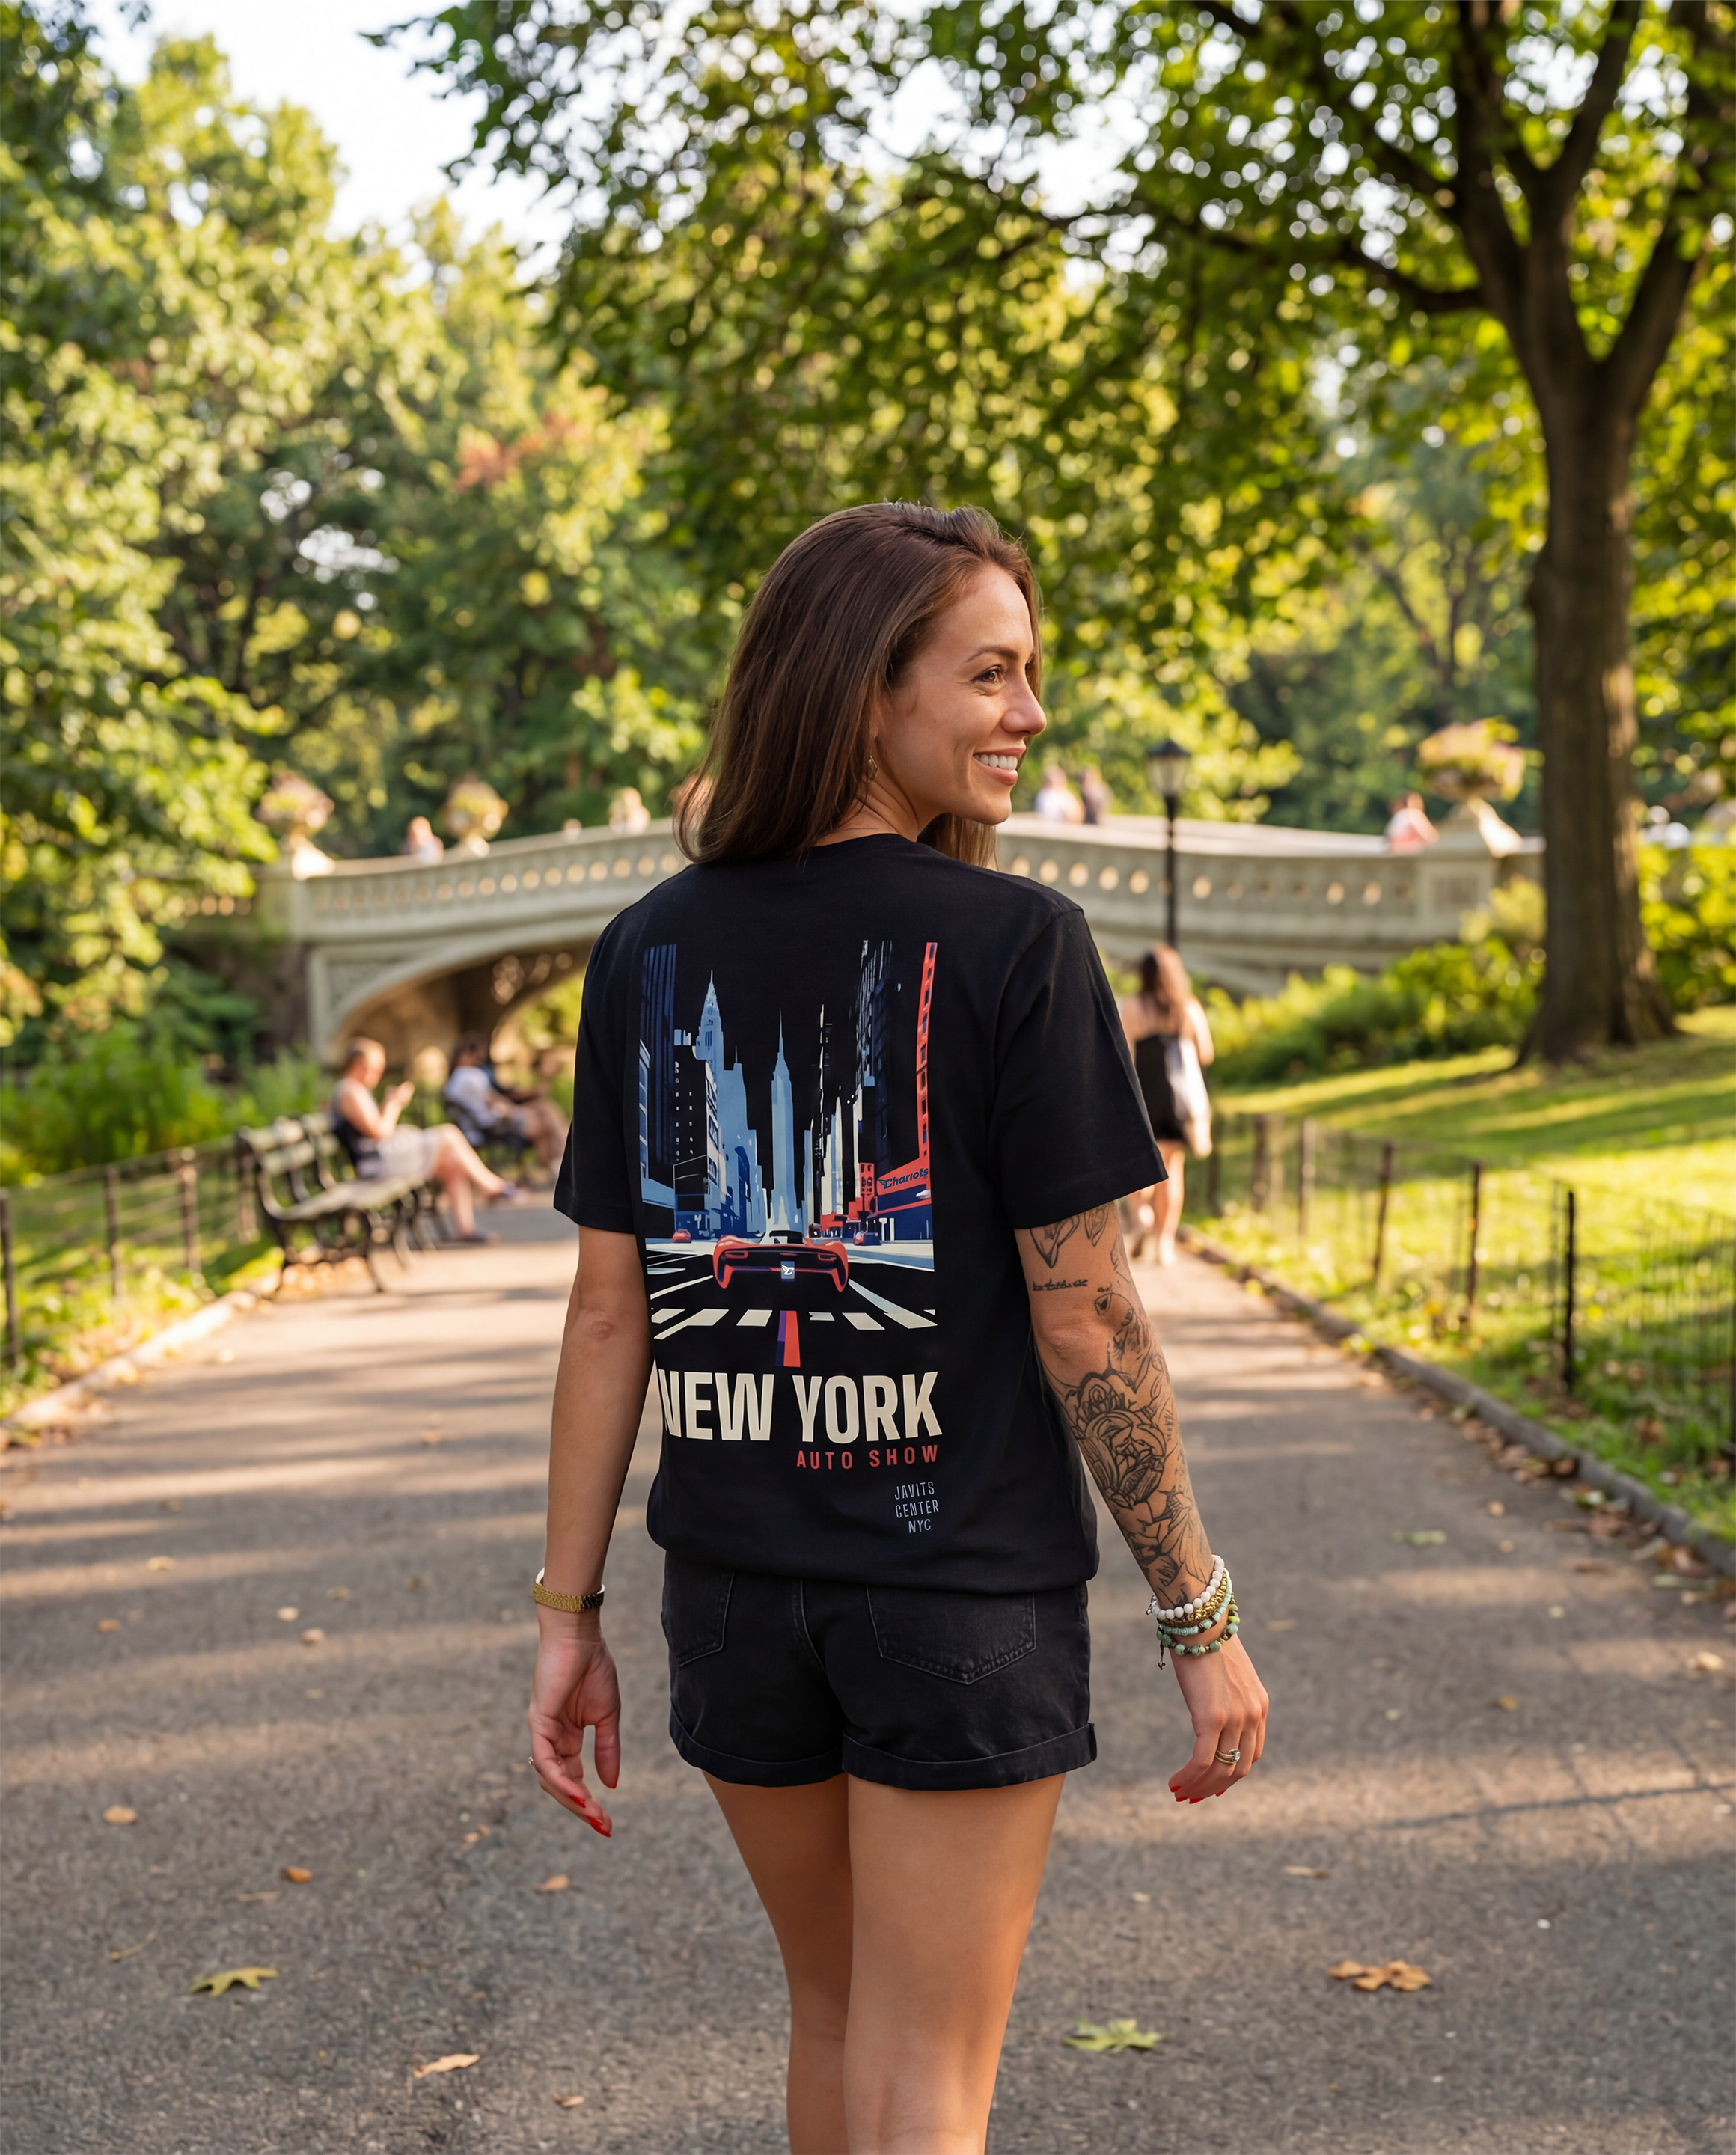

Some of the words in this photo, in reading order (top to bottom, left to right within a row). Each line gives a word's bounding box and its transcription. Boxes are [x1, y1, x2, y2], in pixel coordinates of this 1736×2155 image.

[880, 1167, 929, 1190] Chariots
[658, 1369, 775, 1441] NEW
[792, 1371, 943, 1444] YORK
[796, 1450, 854, 1470] AUTO
[869, 1444, 938, 1468] SHOW
[894, 1481, 935, 1500] JAVITS
[895, 1499, 940, 1518] CENTER
[908, 1518, 932, 1534] NYC
